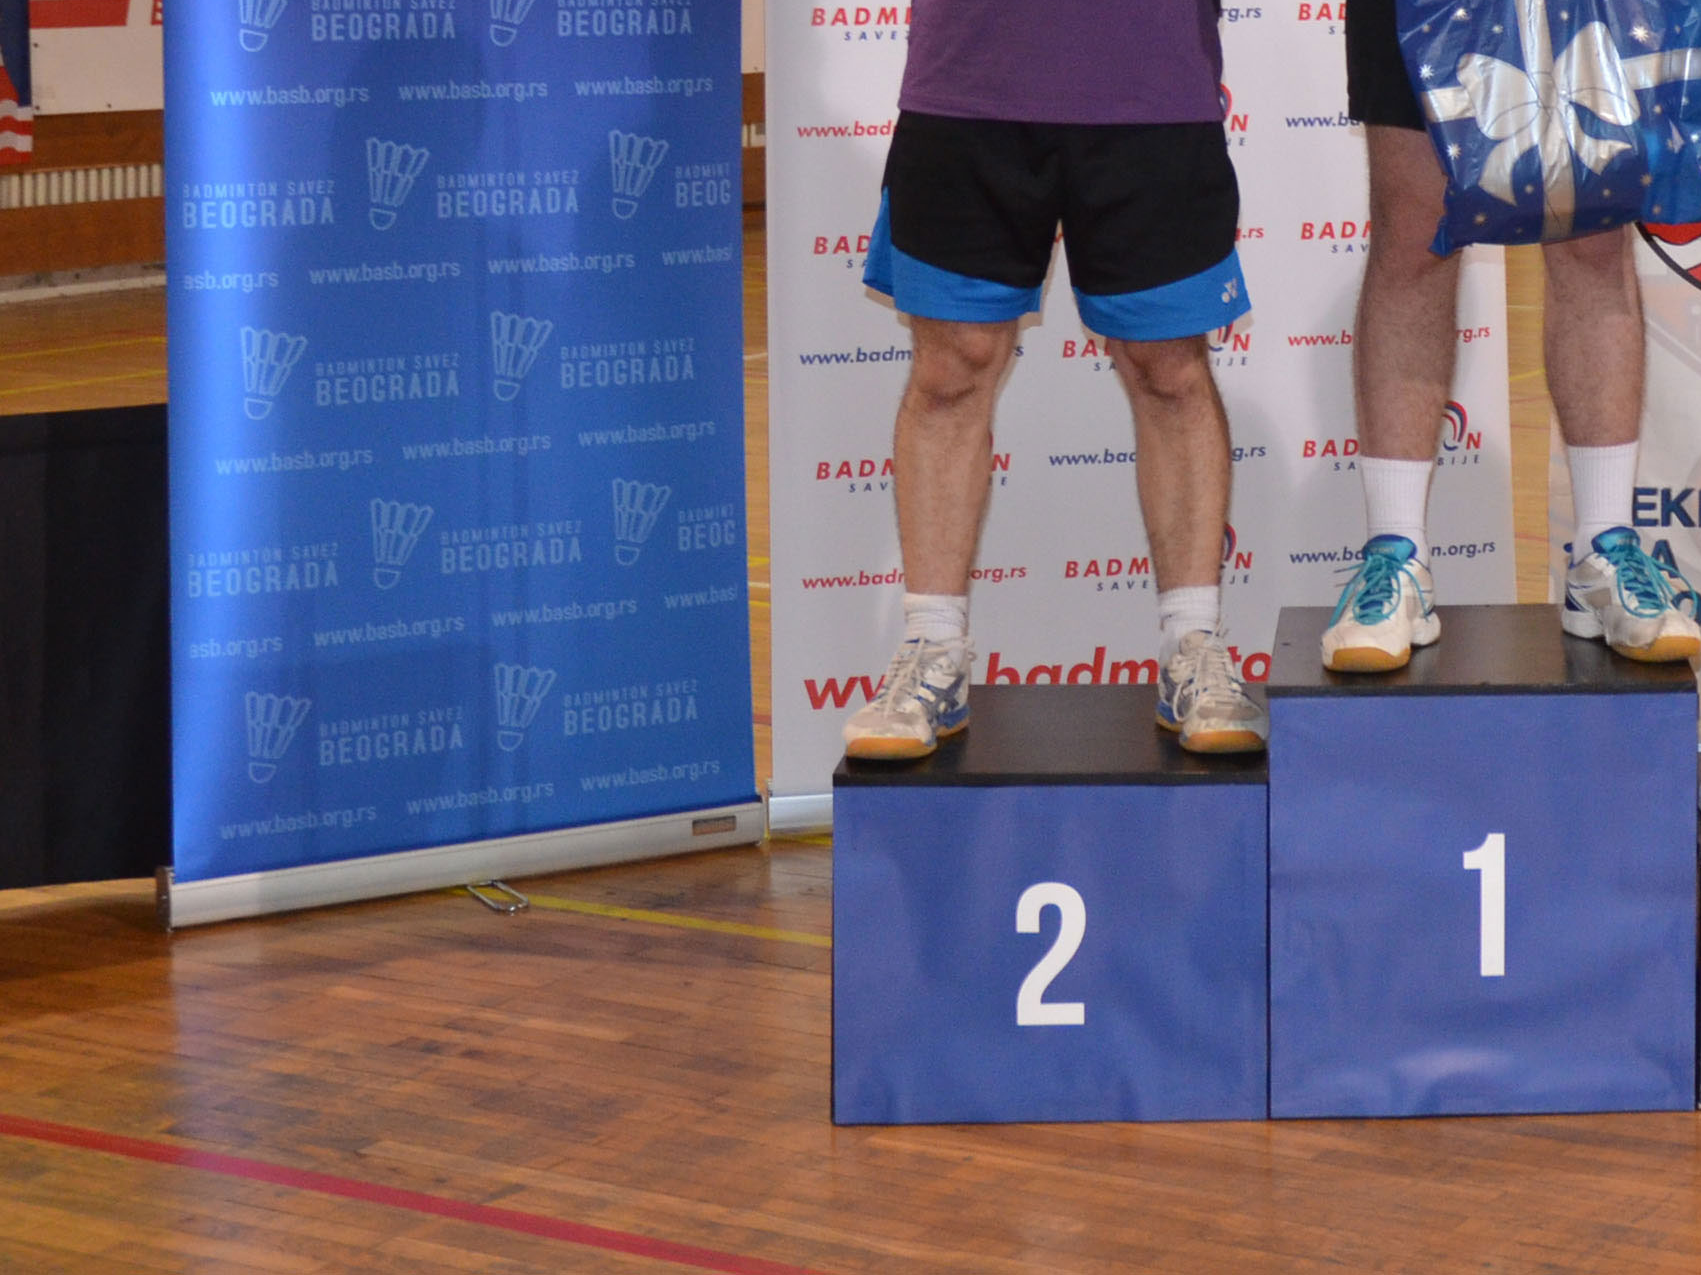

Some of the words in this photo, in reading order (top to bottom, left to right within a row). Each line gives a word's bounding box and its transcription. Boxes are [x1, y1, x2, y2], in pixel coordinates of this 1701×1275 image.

[311, 11, 456, 41] BEOGRADA
[558, 9, 693, 36] BEOGRADA
[210, 86, 370, 108] www.basb.org.rs
[398, 80, 549, 102] www.basb.org.rs
[575, 76, 714, 97] www.basb.org.rs
[437, 172, 525, 189] BADMINTON
[534, 170, 580, 186] SAVEZ
[184, 197, 335, 229] BEOGRADA
[437, 187, 579, 219] BEOGRADA
[309, 260, 460, 283] www.basb.org.rs
[488, 251, 635, 274] www.basb.org.rs
[560, 340, 646, 360] BADMINTON
[653, 338, 696, 355] SAVEZ
[316, 357, 405, 377] BADMINTON
[414, 353, 459, 370] SAVEZ
[560, 354, 695, 389] BEOGRADA
[316, 369, 460, 406] BEOGRADA
[402, 433, 551, 460] www.basb.org.rs
[578, 421, 716, 447] www.basb.org.rs
[215, 449, 373, 475] www.basb.org.rs
[441, 524, 528, 545] BADMINTON
[678, 520, 735, 551] BEOG
[441, 536, 581, 574] BEOGRADA
[188, 559, 339, 598] BEOGRADA
[491, 599, 637, 628] www.basb.org.rs
[313, 616, 464, 646] www.basb.org.rs
[564, 685, 648, 708] BADMINTON
[564, 695, 699, 737] BEOGRADA
[320, 724, 463, 766] BEOGRADA
[580, 760, 720, 792] www.basb.org.rs
[405, 781, 554, 815] www.basb.org.rs
[221, 806, 377, 840] www.basb.org.rs
[1461, 832, 1507, 978] 1
[1014, 881, 1087, 1028] 2
